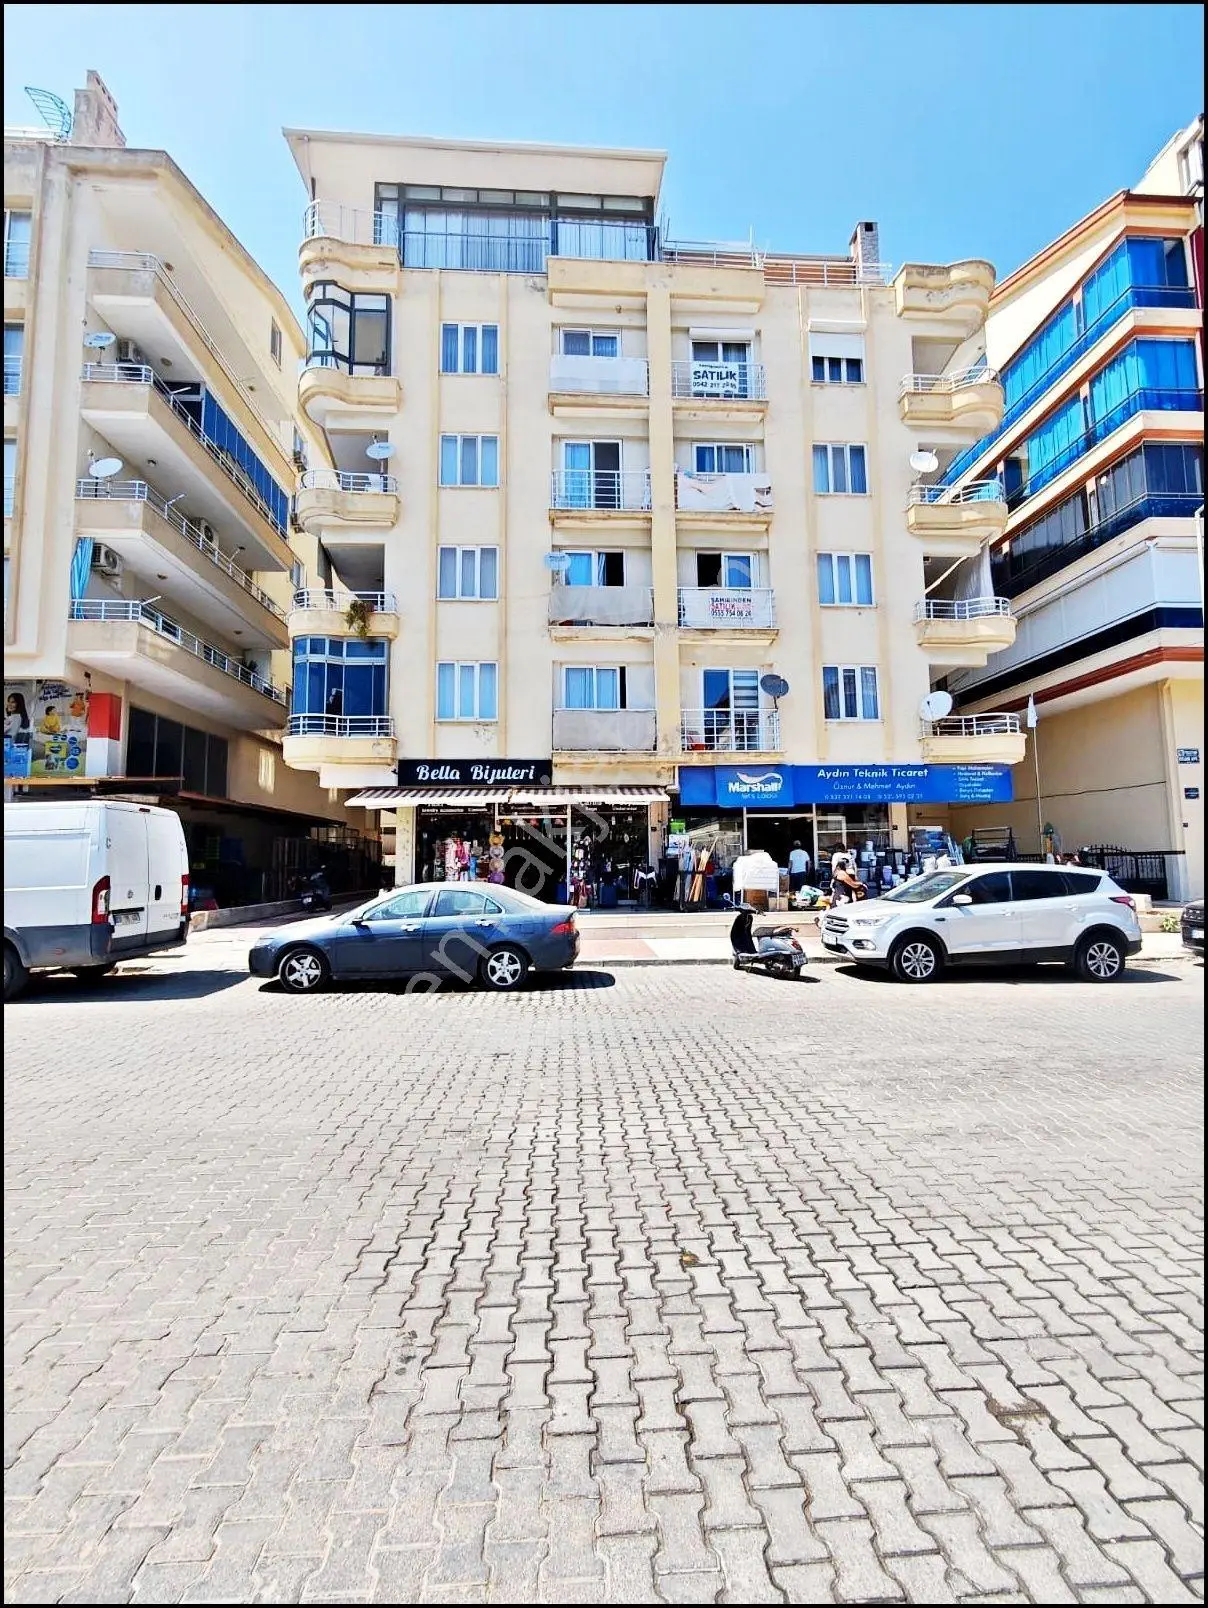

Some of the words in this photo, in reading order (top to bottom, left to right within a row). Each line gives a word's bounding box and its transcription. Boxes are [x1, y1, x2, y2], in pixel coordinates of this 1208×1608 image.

[693, 370, 736, 382] SATILIK
[416, 764, 460, 781] Bella
[470, 764, 535, 785] Bijuteri
[817, 768, 850, 780] Aydın
[853, 768, 888, 778] Teknik
[892, 768, 929, 778] Ticaret
[728, 782, 780, 793] Marshall
